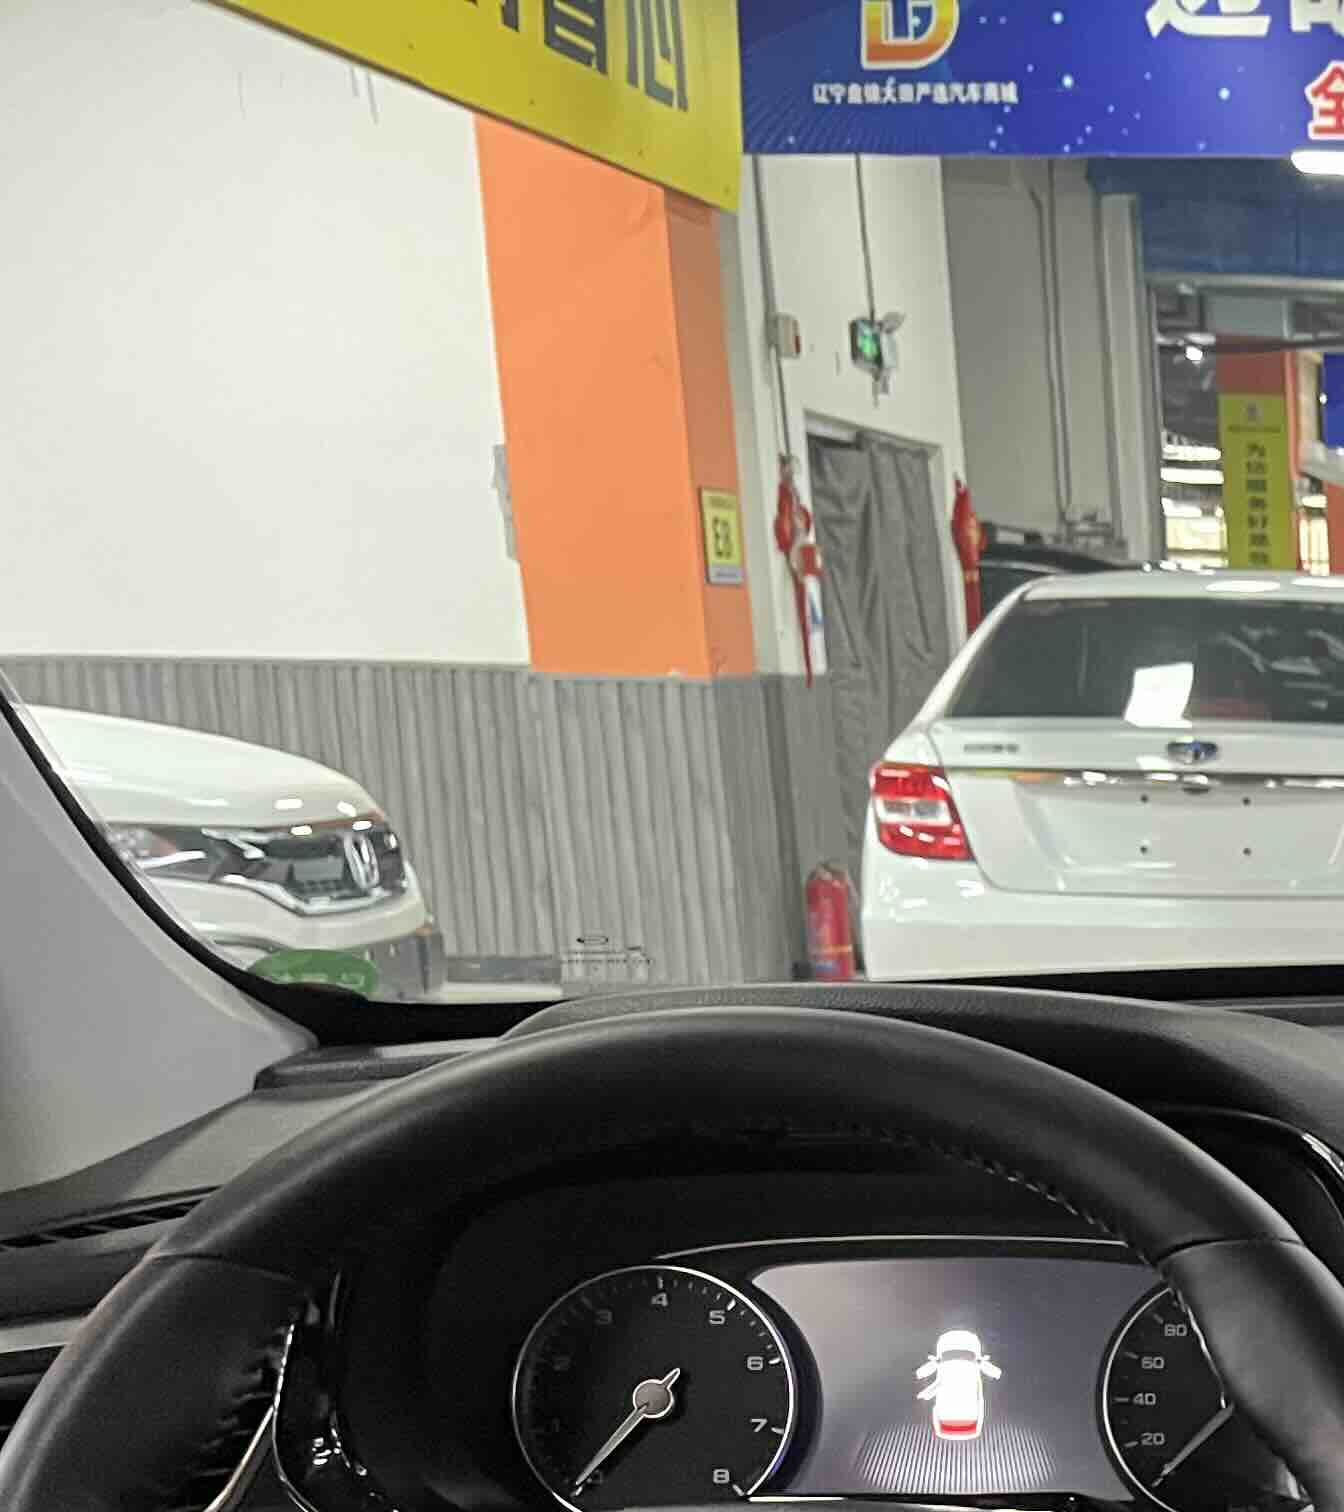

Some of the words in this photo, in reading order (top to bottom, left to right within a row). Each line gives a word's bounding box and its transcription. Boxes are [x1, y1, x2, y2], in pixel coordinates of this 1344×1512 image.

[708, 1310, 726, 1326] 5
[746, 1355, 764, 1371] 6
[1140, 1356, 1165, 1369] 60
[1133, 1392, 1157, 1406] 40
[751, 1417, 769, 1433] 7
[1141, 1432, 1166, 1446] 20
[712, 1467, 730, 1484] 8
